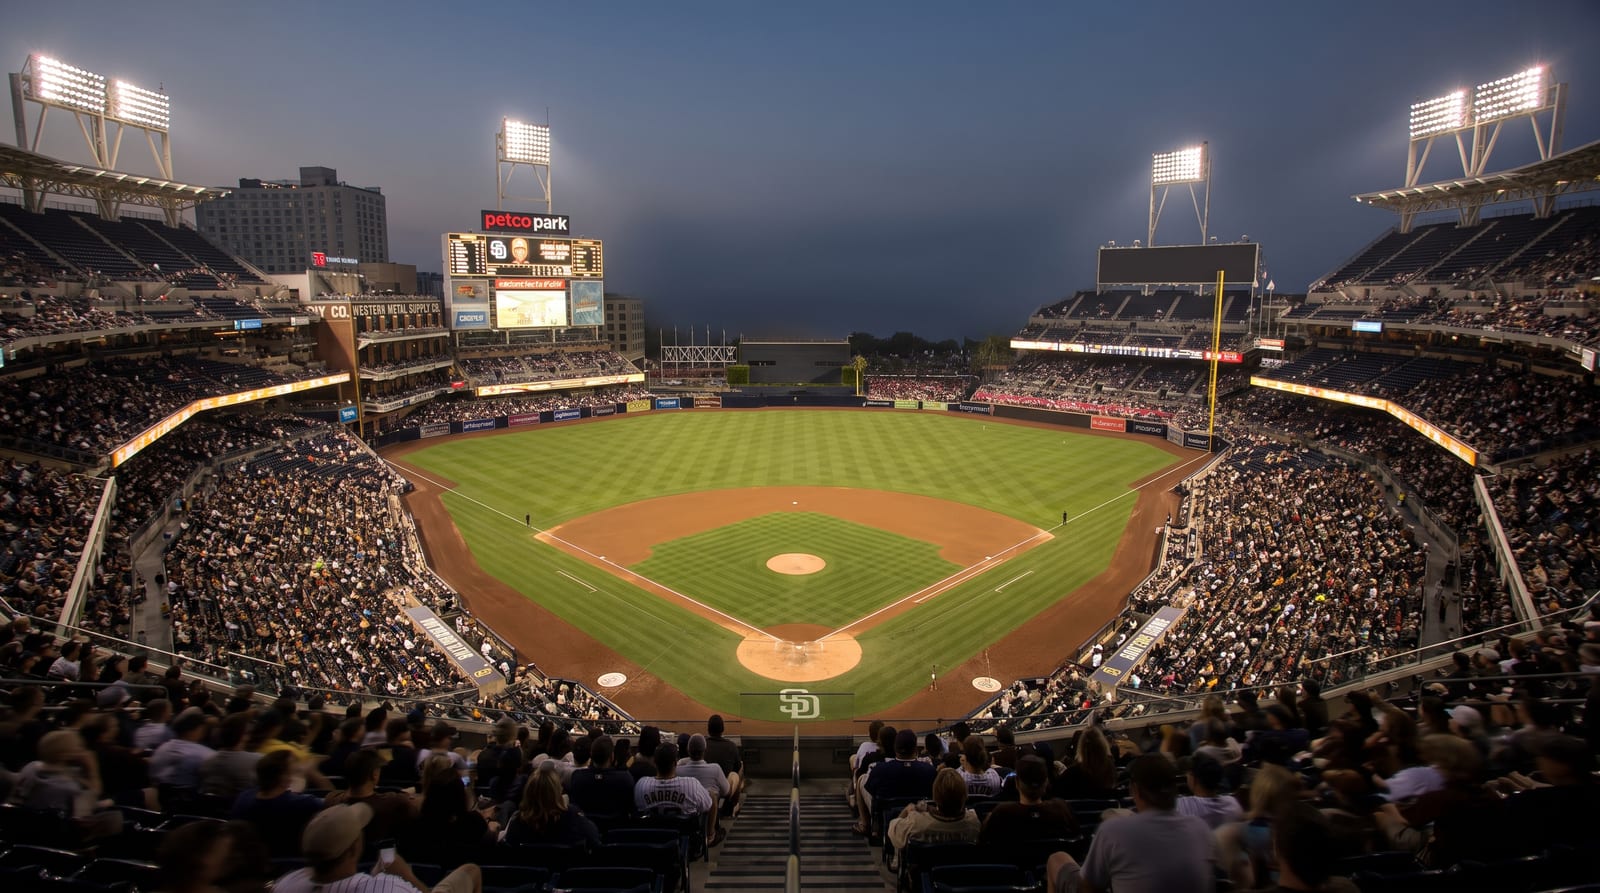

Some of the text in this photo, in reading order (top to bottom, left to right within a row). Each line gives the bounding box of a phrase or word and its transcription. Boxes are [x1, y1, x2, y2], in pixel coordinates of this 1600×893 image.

[485, 213, 568, 231] petco park
[490, 240, 507, 259] SD
[331, 305, 350, 318] CO.
[352, 304, 386, 316] WESTERN
[387, 304, 408, 315] METAL
[408, 303, 431, 314] SUPPLY
[780, 688, 820, 719] SD
